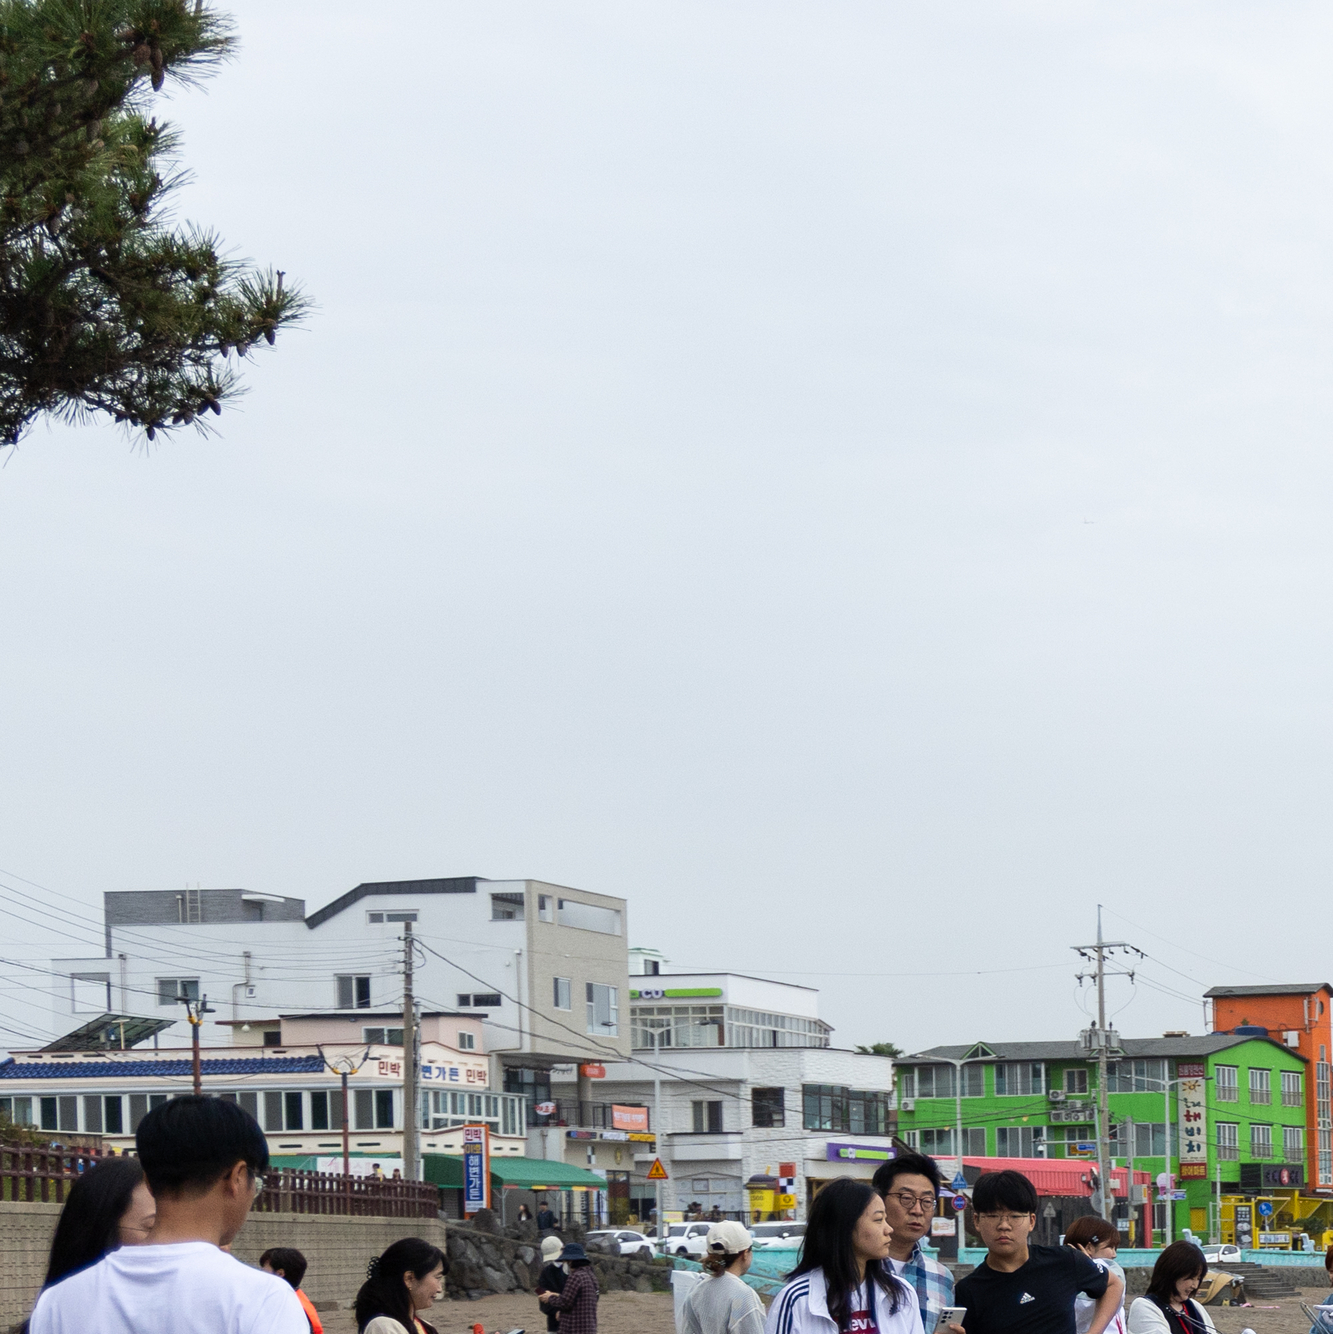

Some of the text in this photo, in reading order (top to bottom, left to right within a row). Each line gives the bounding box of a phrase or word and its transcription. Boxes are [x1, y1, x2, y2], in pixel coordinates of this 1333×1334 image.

[641, 988, 663, 999] CU
[378, 1060, 487, 1084] 민박 변가든 민박
[465, 1128, 481, 1141] 민박
[469, 1155, 480, 1200] 해변가든
